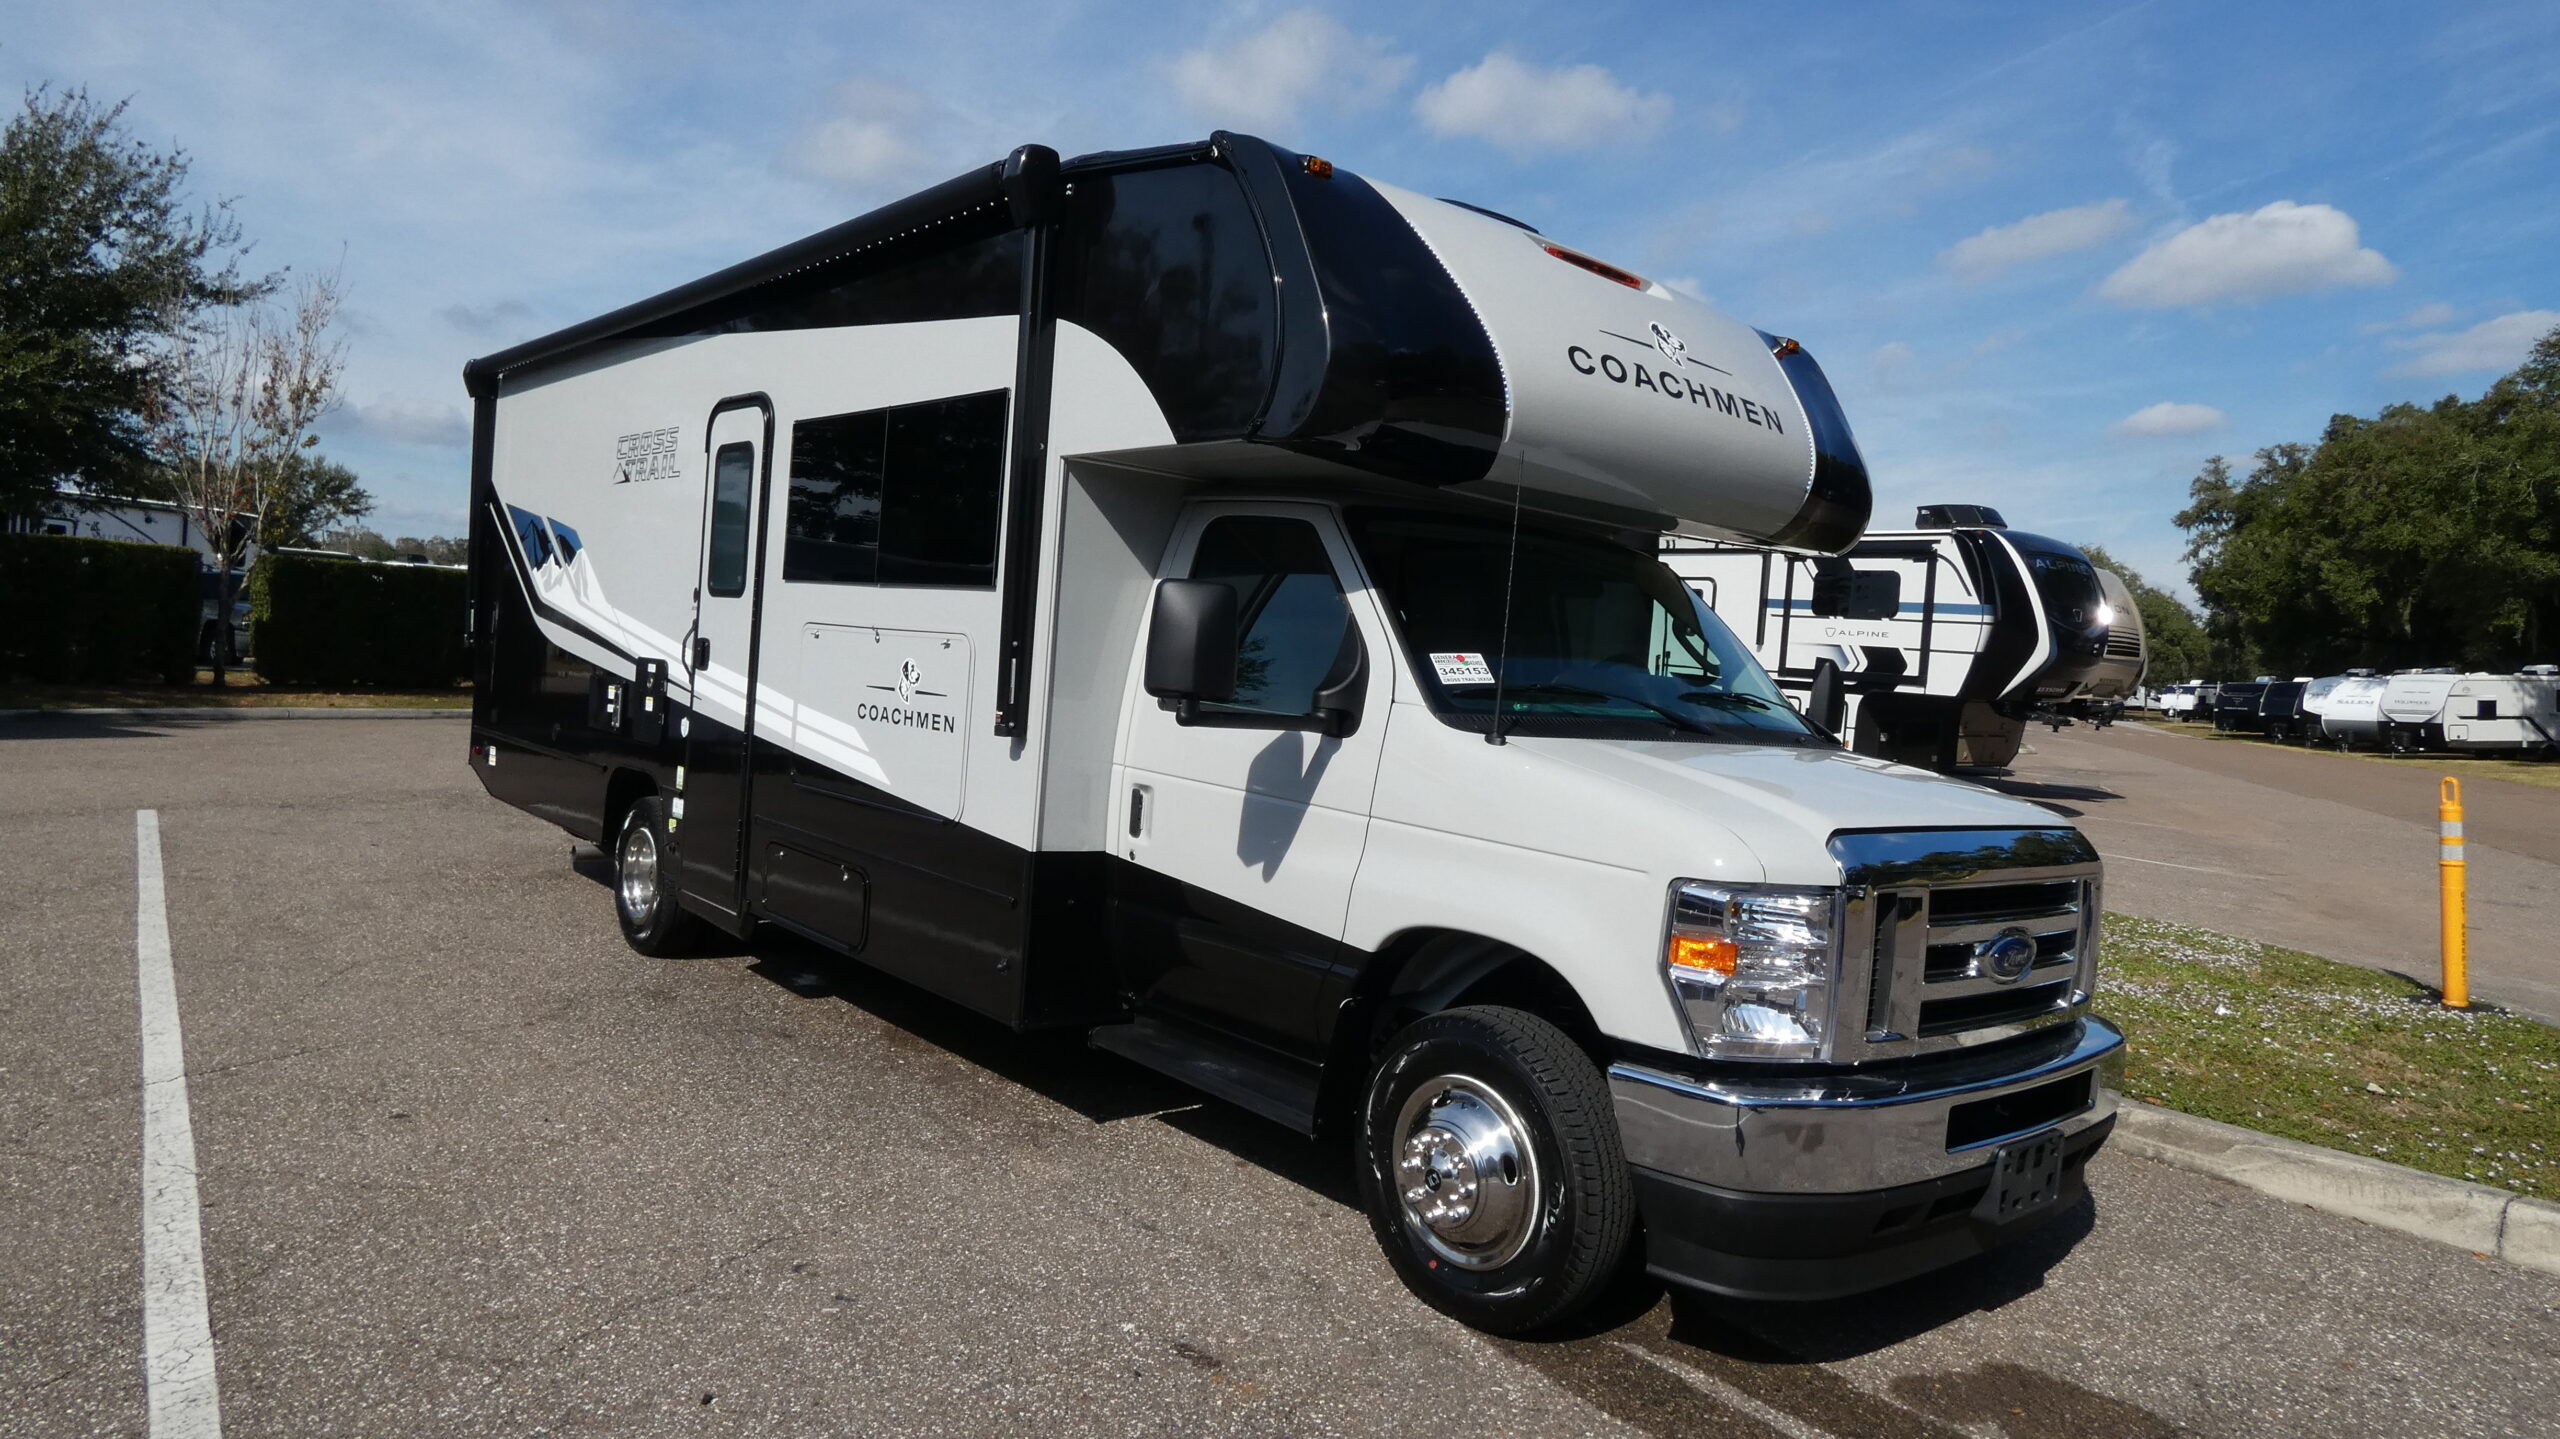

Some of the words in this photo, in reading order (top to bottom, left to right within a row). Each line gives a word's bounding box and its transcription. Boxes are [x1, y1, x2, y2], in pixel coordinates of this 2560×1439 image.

[1568, 345, 1784, 435] COACHMEN
[616, 426, 680, 460] CROSS
[625, 453, 681, 482] TRAIL
[2036, 558, 2092, 576] ALPINE
[1838, 630, 1889, 638] ALPINE
[1440, 667, 1489, 675] 345153
[857, 703, 955, 734] COACHMEN
[2005, 947, 2028, 966] Ford
